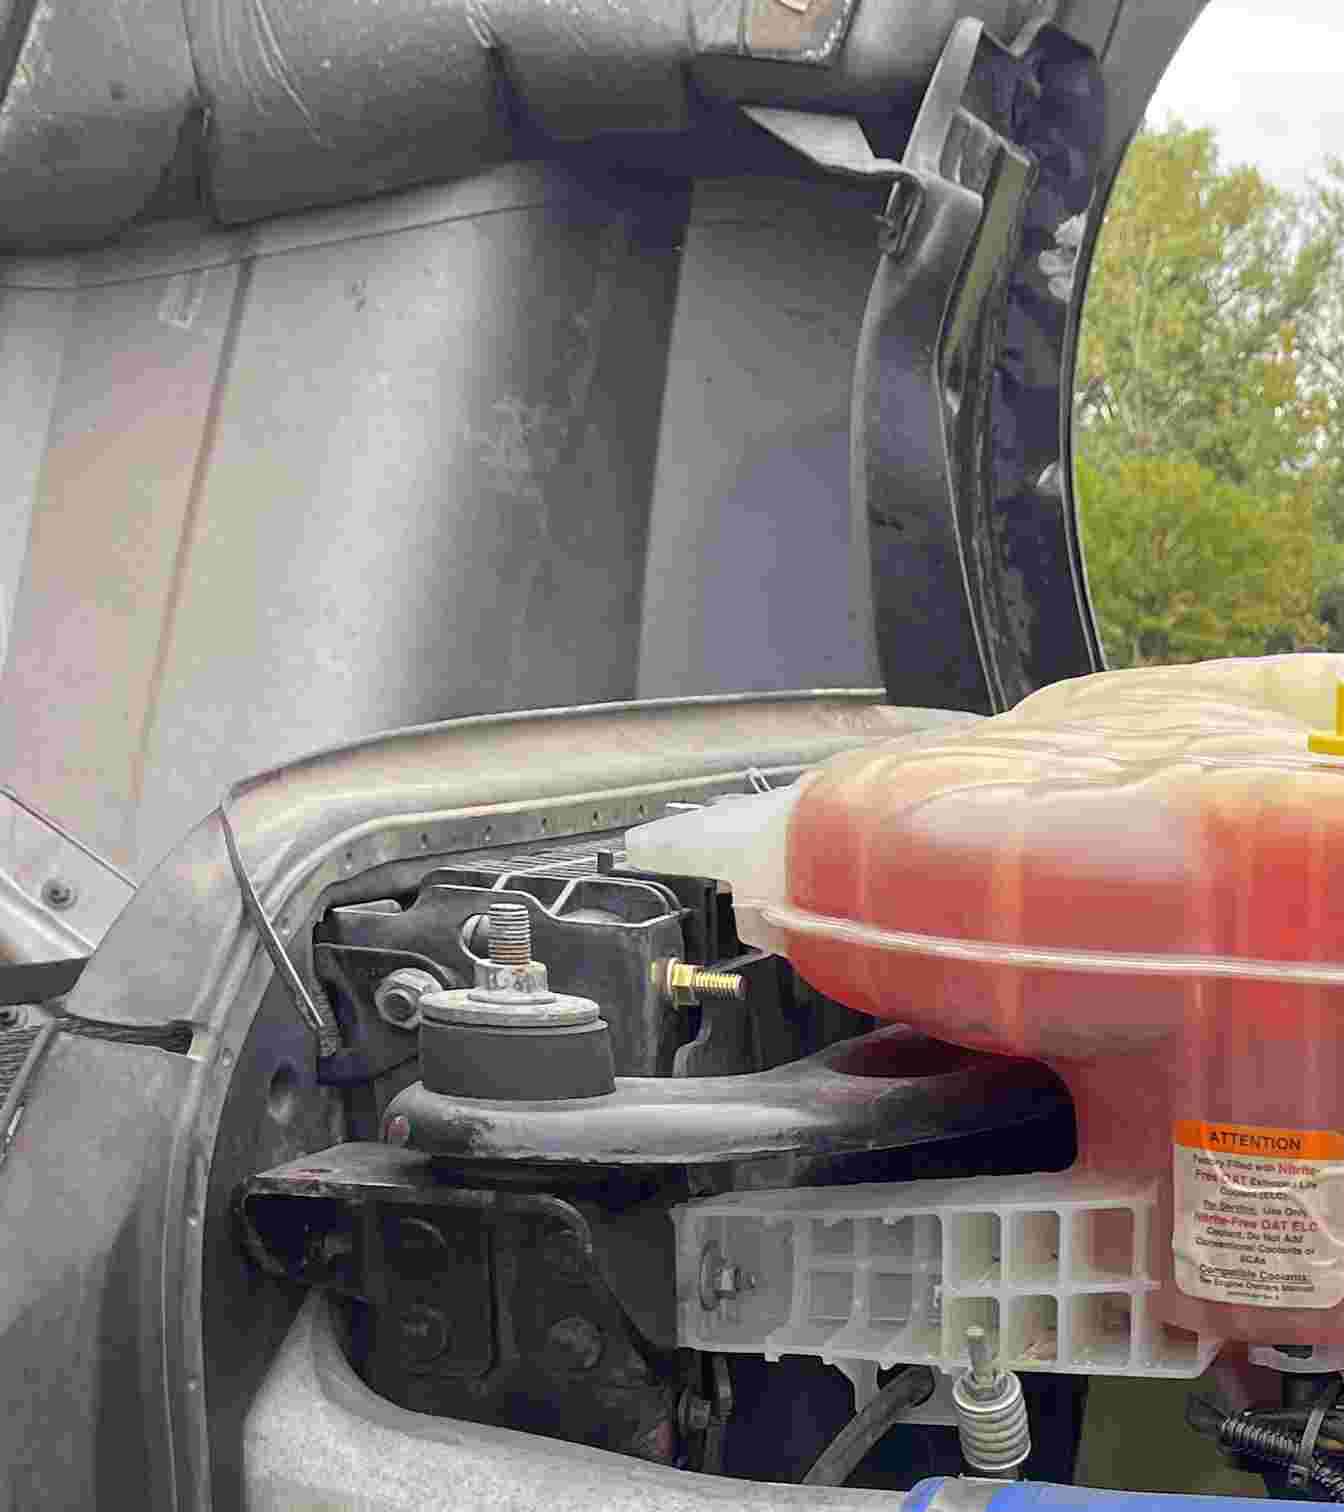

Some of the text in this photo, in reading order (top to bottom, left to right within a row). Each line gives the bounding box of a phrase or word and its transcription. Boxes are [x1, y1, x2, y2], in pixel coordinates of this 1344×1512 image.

[1208, 1132, 1301, 1151] ATTENTION
[1261, 1219, 1288, 1231] OAT
[1292, 1221, 1318, 1233] ELC
